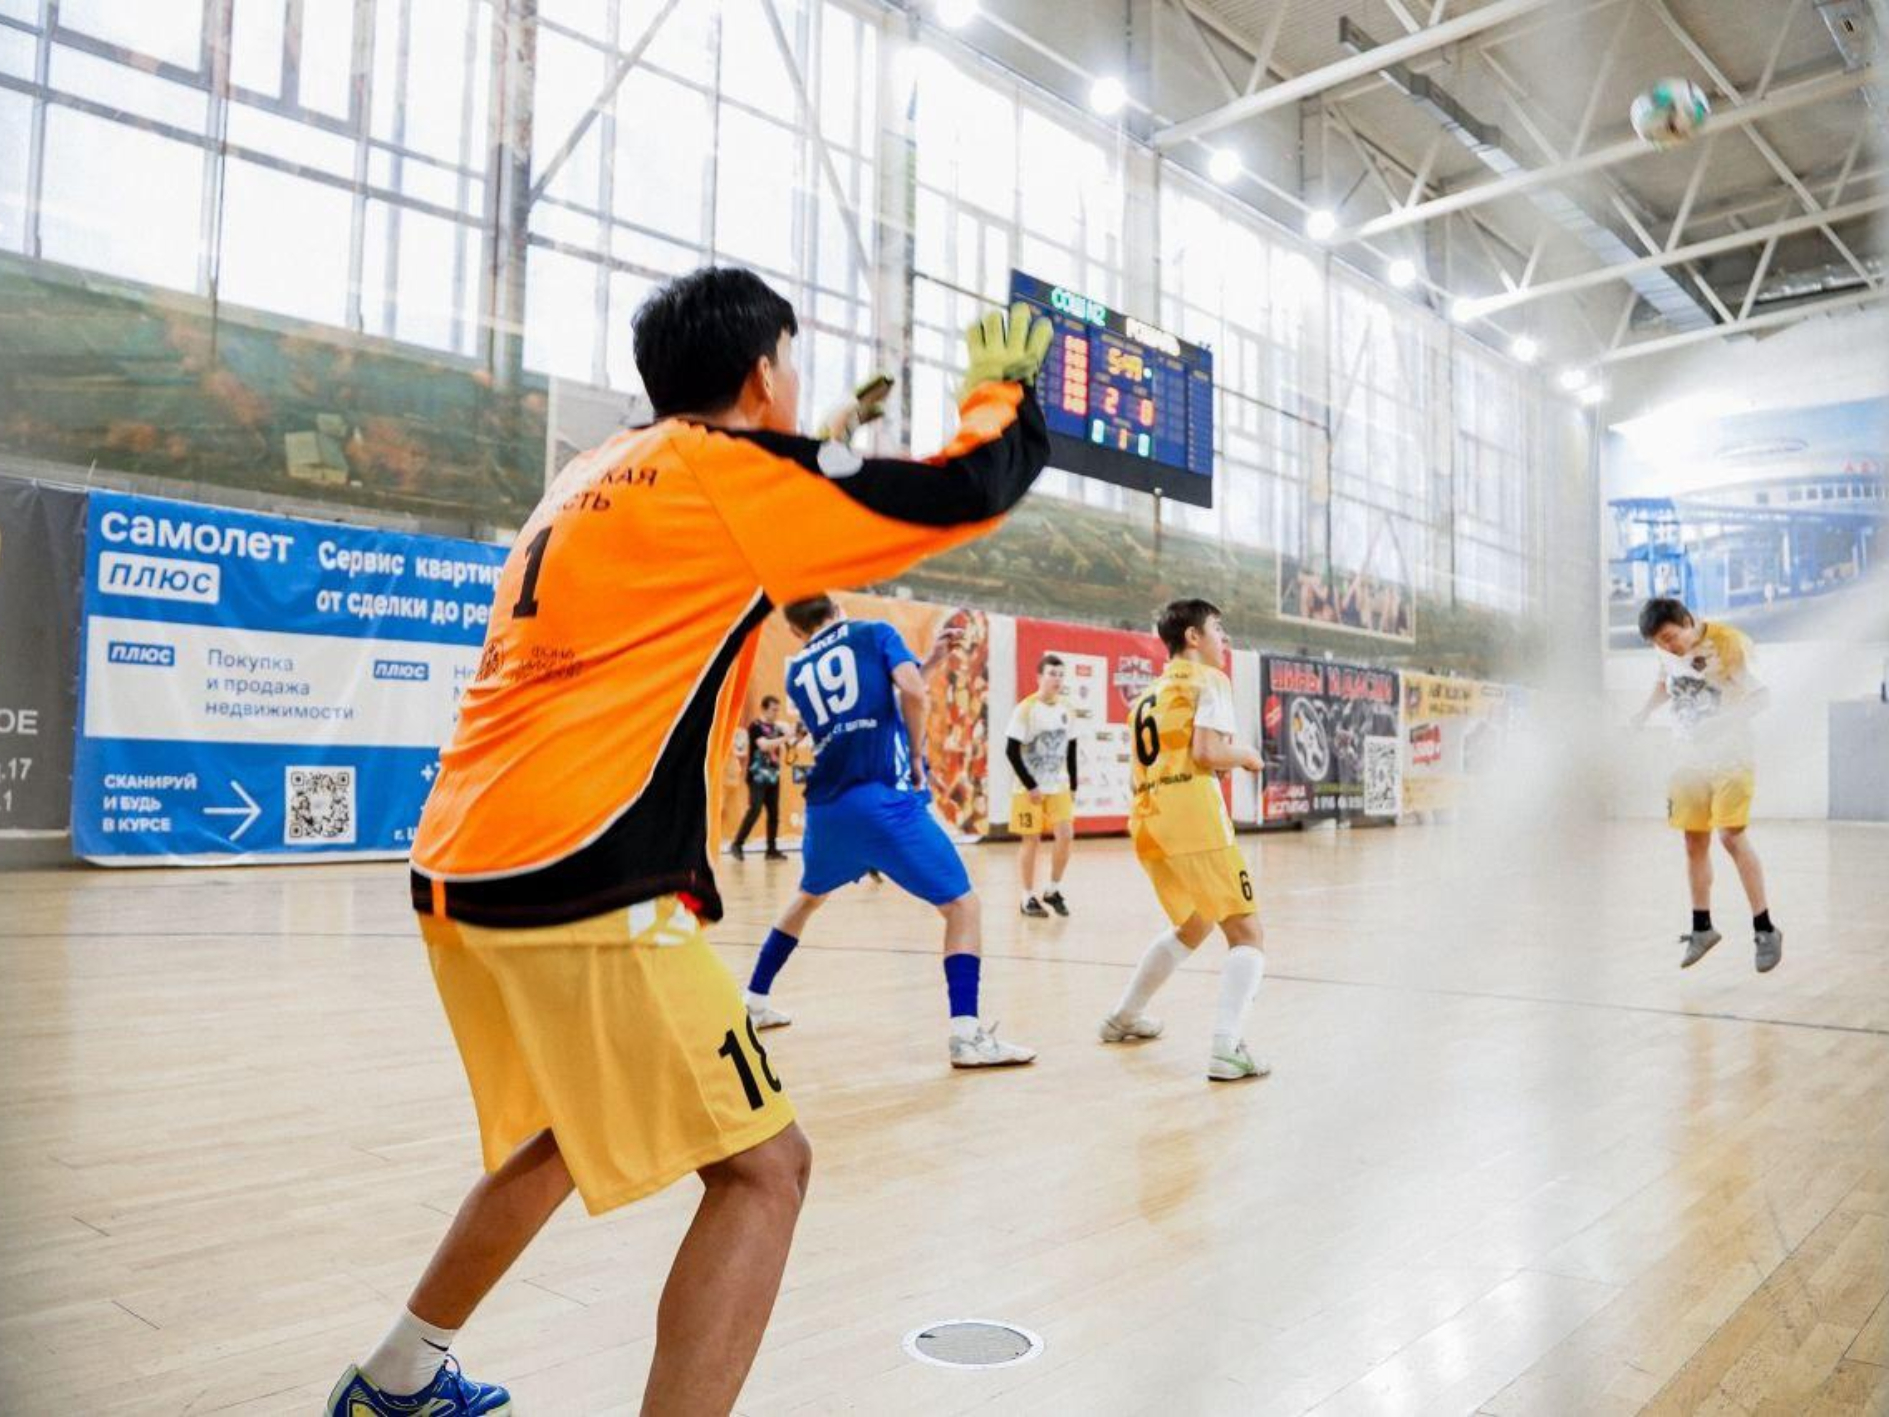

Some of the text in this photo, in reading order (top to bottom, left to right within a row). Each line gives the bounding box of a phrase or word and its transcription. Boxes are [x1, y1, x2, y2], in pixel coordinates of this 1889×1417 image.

[101, 511, 294, 563] самолет
[318, 541, 405, 577] Сервис
[512, 526, 553, 620] 1
[316, 590, 492, 630] от сделки до ре
[208, 649, 294, 673] Покупка
[207, 677, 310, 697] и продажа
[794, 645, 859, 726] 19
[205, 702, 354, 720] недвижимости
[1134, 694, 1160, 767] 6
[104, 773, 197, 790] СКАНИРУЙ
[103, 796, 162, 813] И БУДЬ
[103, 817, 171, 833] В КУРСЕ
[1019, 812, 1033, 829] 13
[1239, 870, 1253, 902] 6
